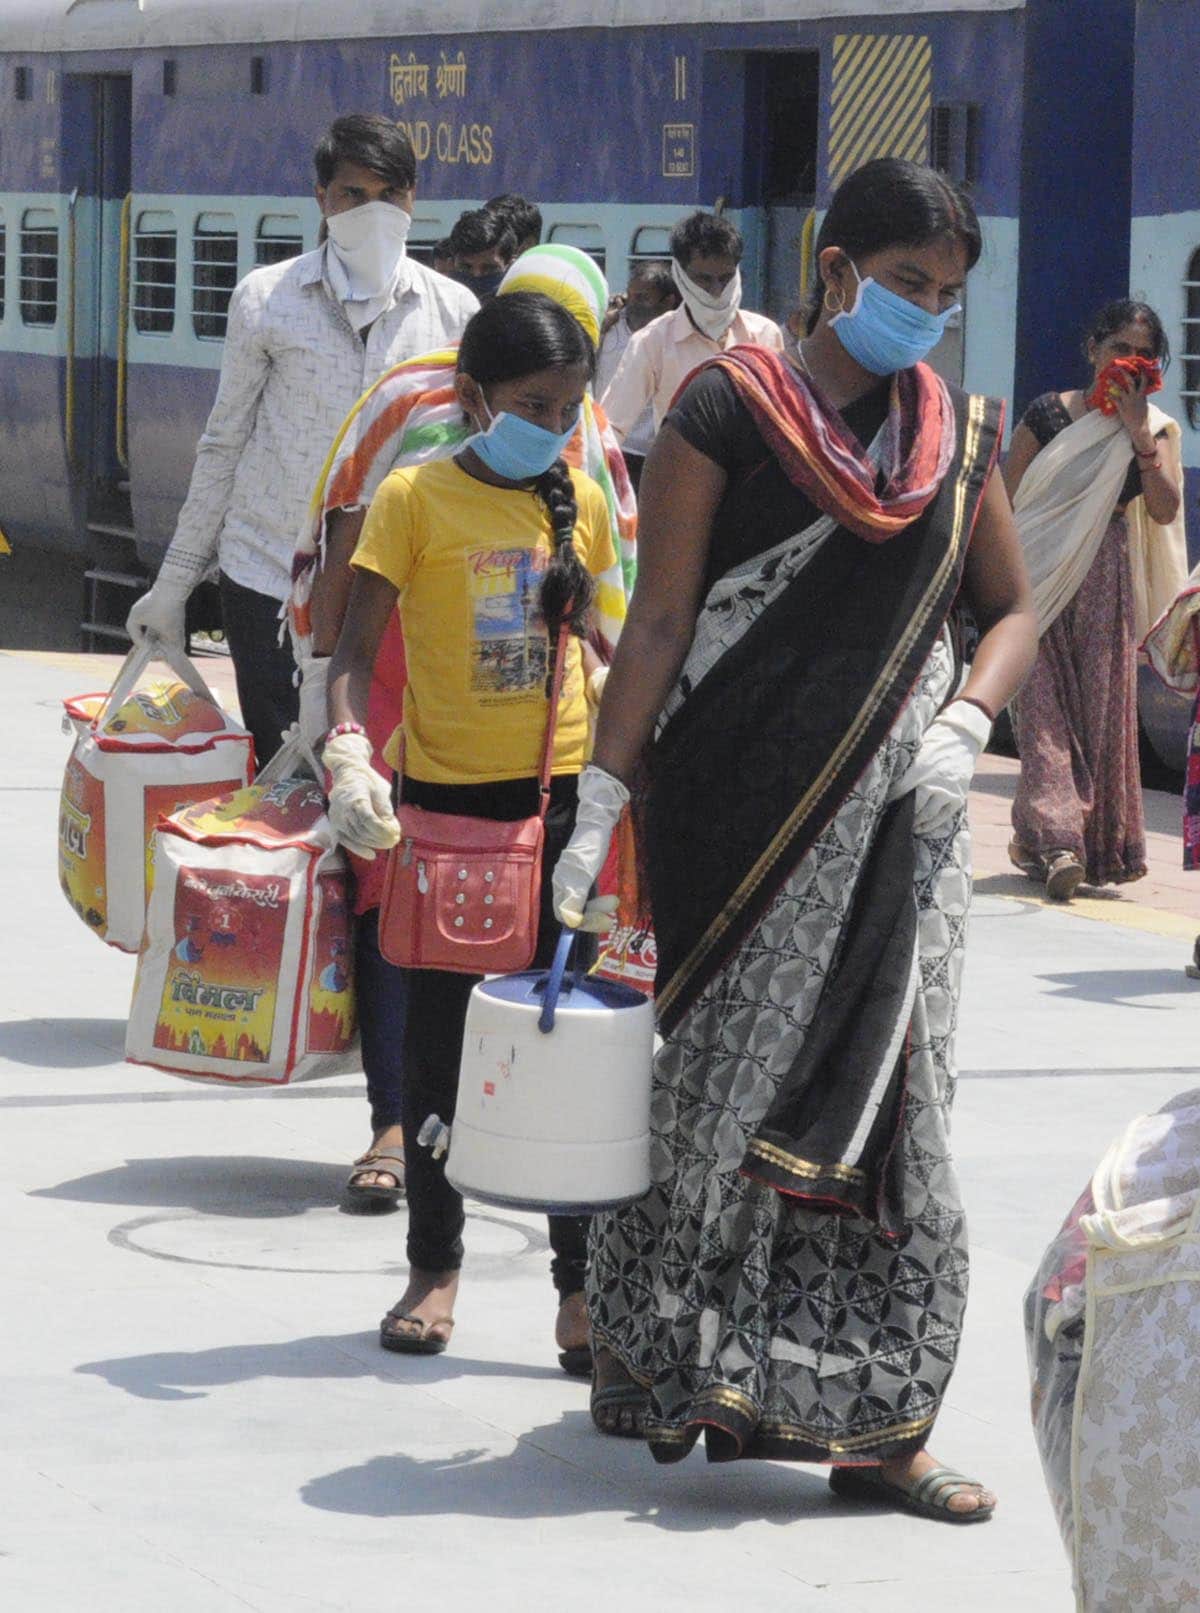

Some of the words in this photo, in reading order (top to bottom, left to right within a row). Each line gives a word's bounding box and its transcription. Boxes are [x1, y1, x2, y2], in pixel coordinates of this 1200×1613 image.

[389, 52, 430, 105] द्वितीय
[436, 50, 467, 98] श्रेणी
[437, 122, 493, 164] CLASS
[171, 967, 264, 1012] विमल
